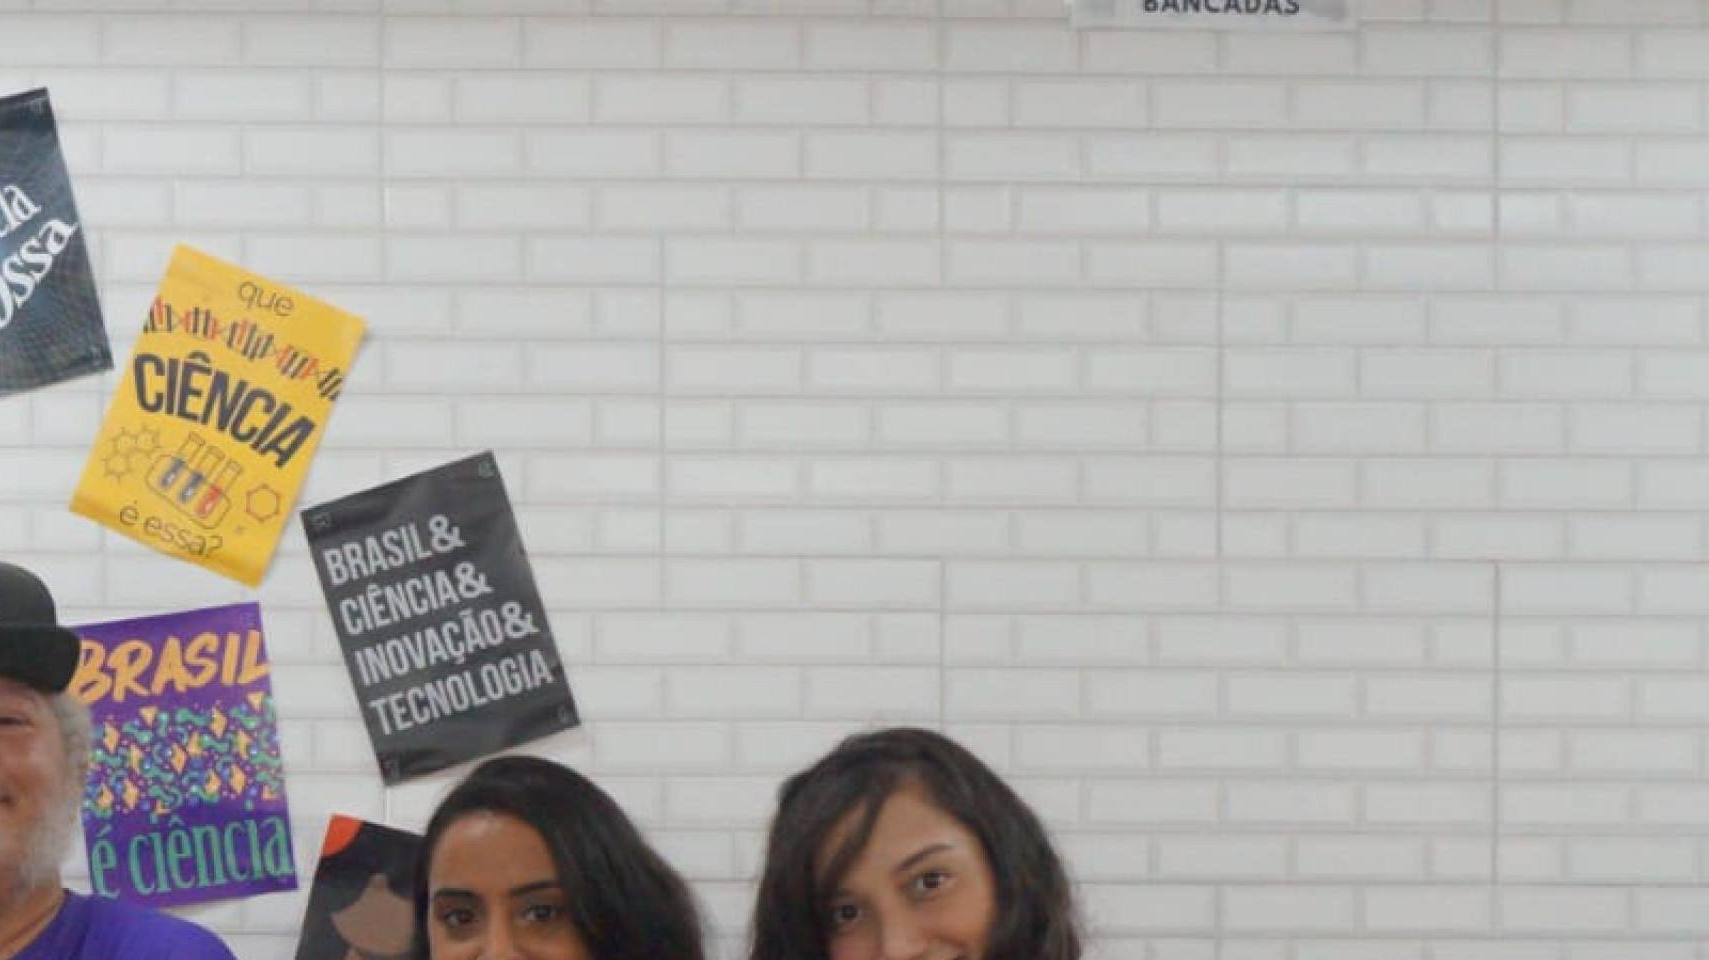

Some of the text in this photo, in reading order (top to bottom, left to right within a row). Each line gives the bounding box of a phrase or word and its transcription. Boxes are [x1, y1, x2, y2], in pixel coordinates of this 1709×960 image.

[1144, 0, 1300, 15] BANCADAS
[237, 280, 295, 317] que
[134, 351, 315, 468] CIÊNCIA
[143, 515, 224, 558] essa?
[69, 629, 273, 705] BRASIL
[368, 649, 555, 736] TECNOLOGIA
[91, 799, 293, 900] é ciência
